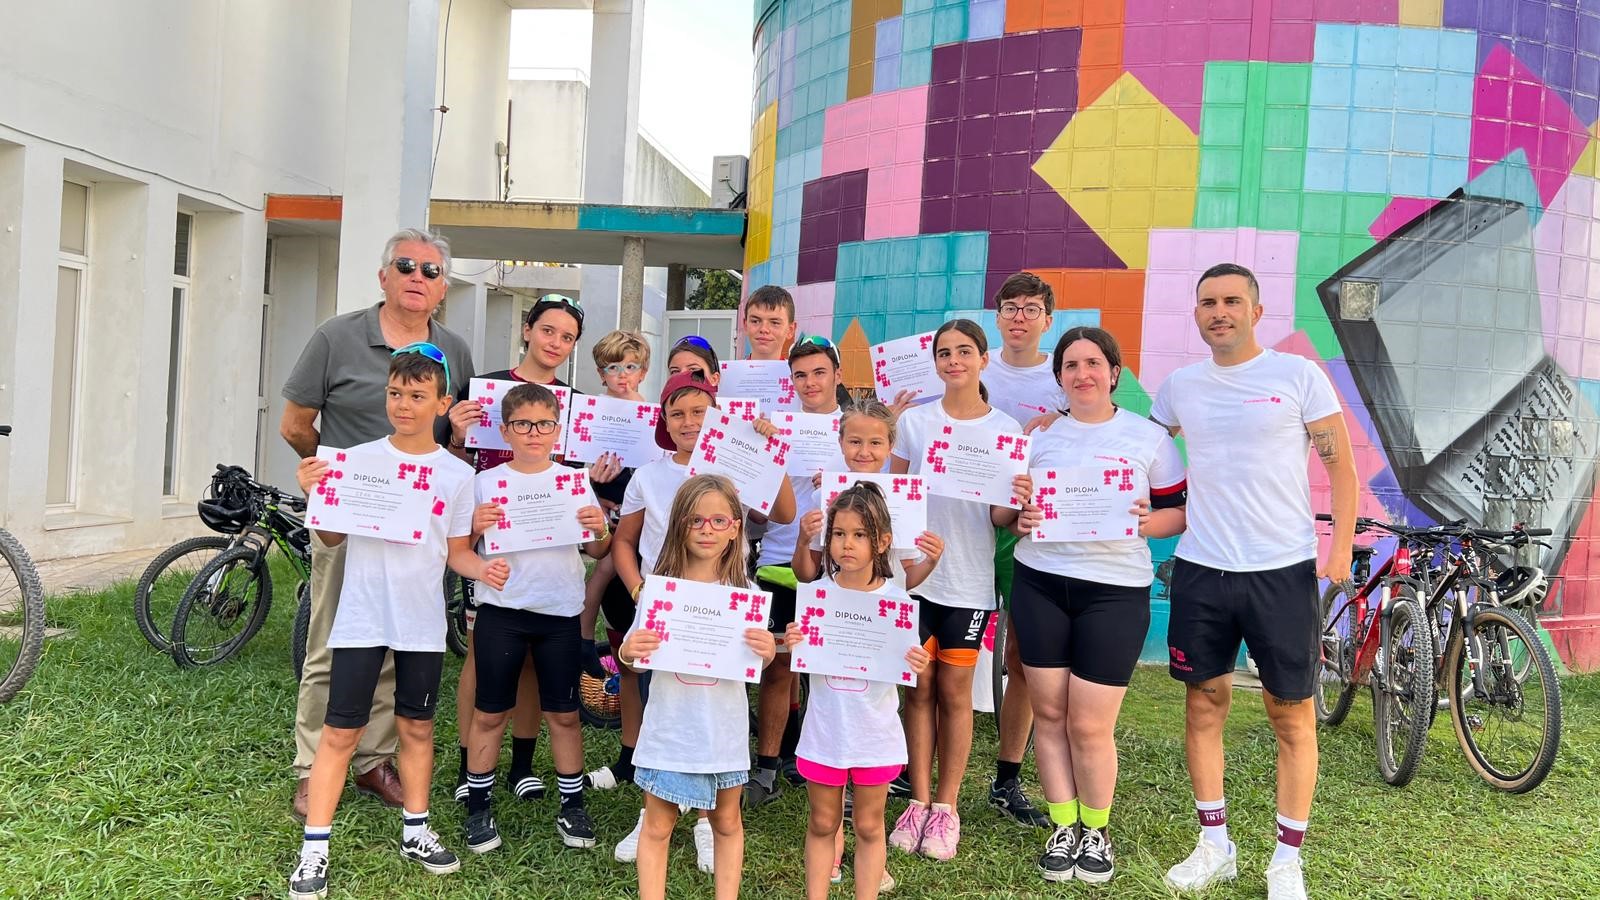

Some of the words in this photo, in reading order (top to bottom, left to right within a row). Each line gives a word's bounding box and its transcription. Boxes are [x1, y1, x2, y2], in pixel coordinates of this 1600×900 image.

[892, 353, 918, 362] DIPLOMA
[602, 415, 631, 423] DIPLOMA
[800, 429, 827, 437] DIPLOMA
[731, 438, 758, 454] DIPLOMA
[958, 445, 989, 455] DIPLOMA
[353, 473, 390, 485] DIPLOMA
[518, 492, 551, 502] DIPLOMA
[684, 605, 721, 617] DIPLOMA
[835, 611, 872, 623] DIPLOMA
[965, 610, 984, 640] MES
